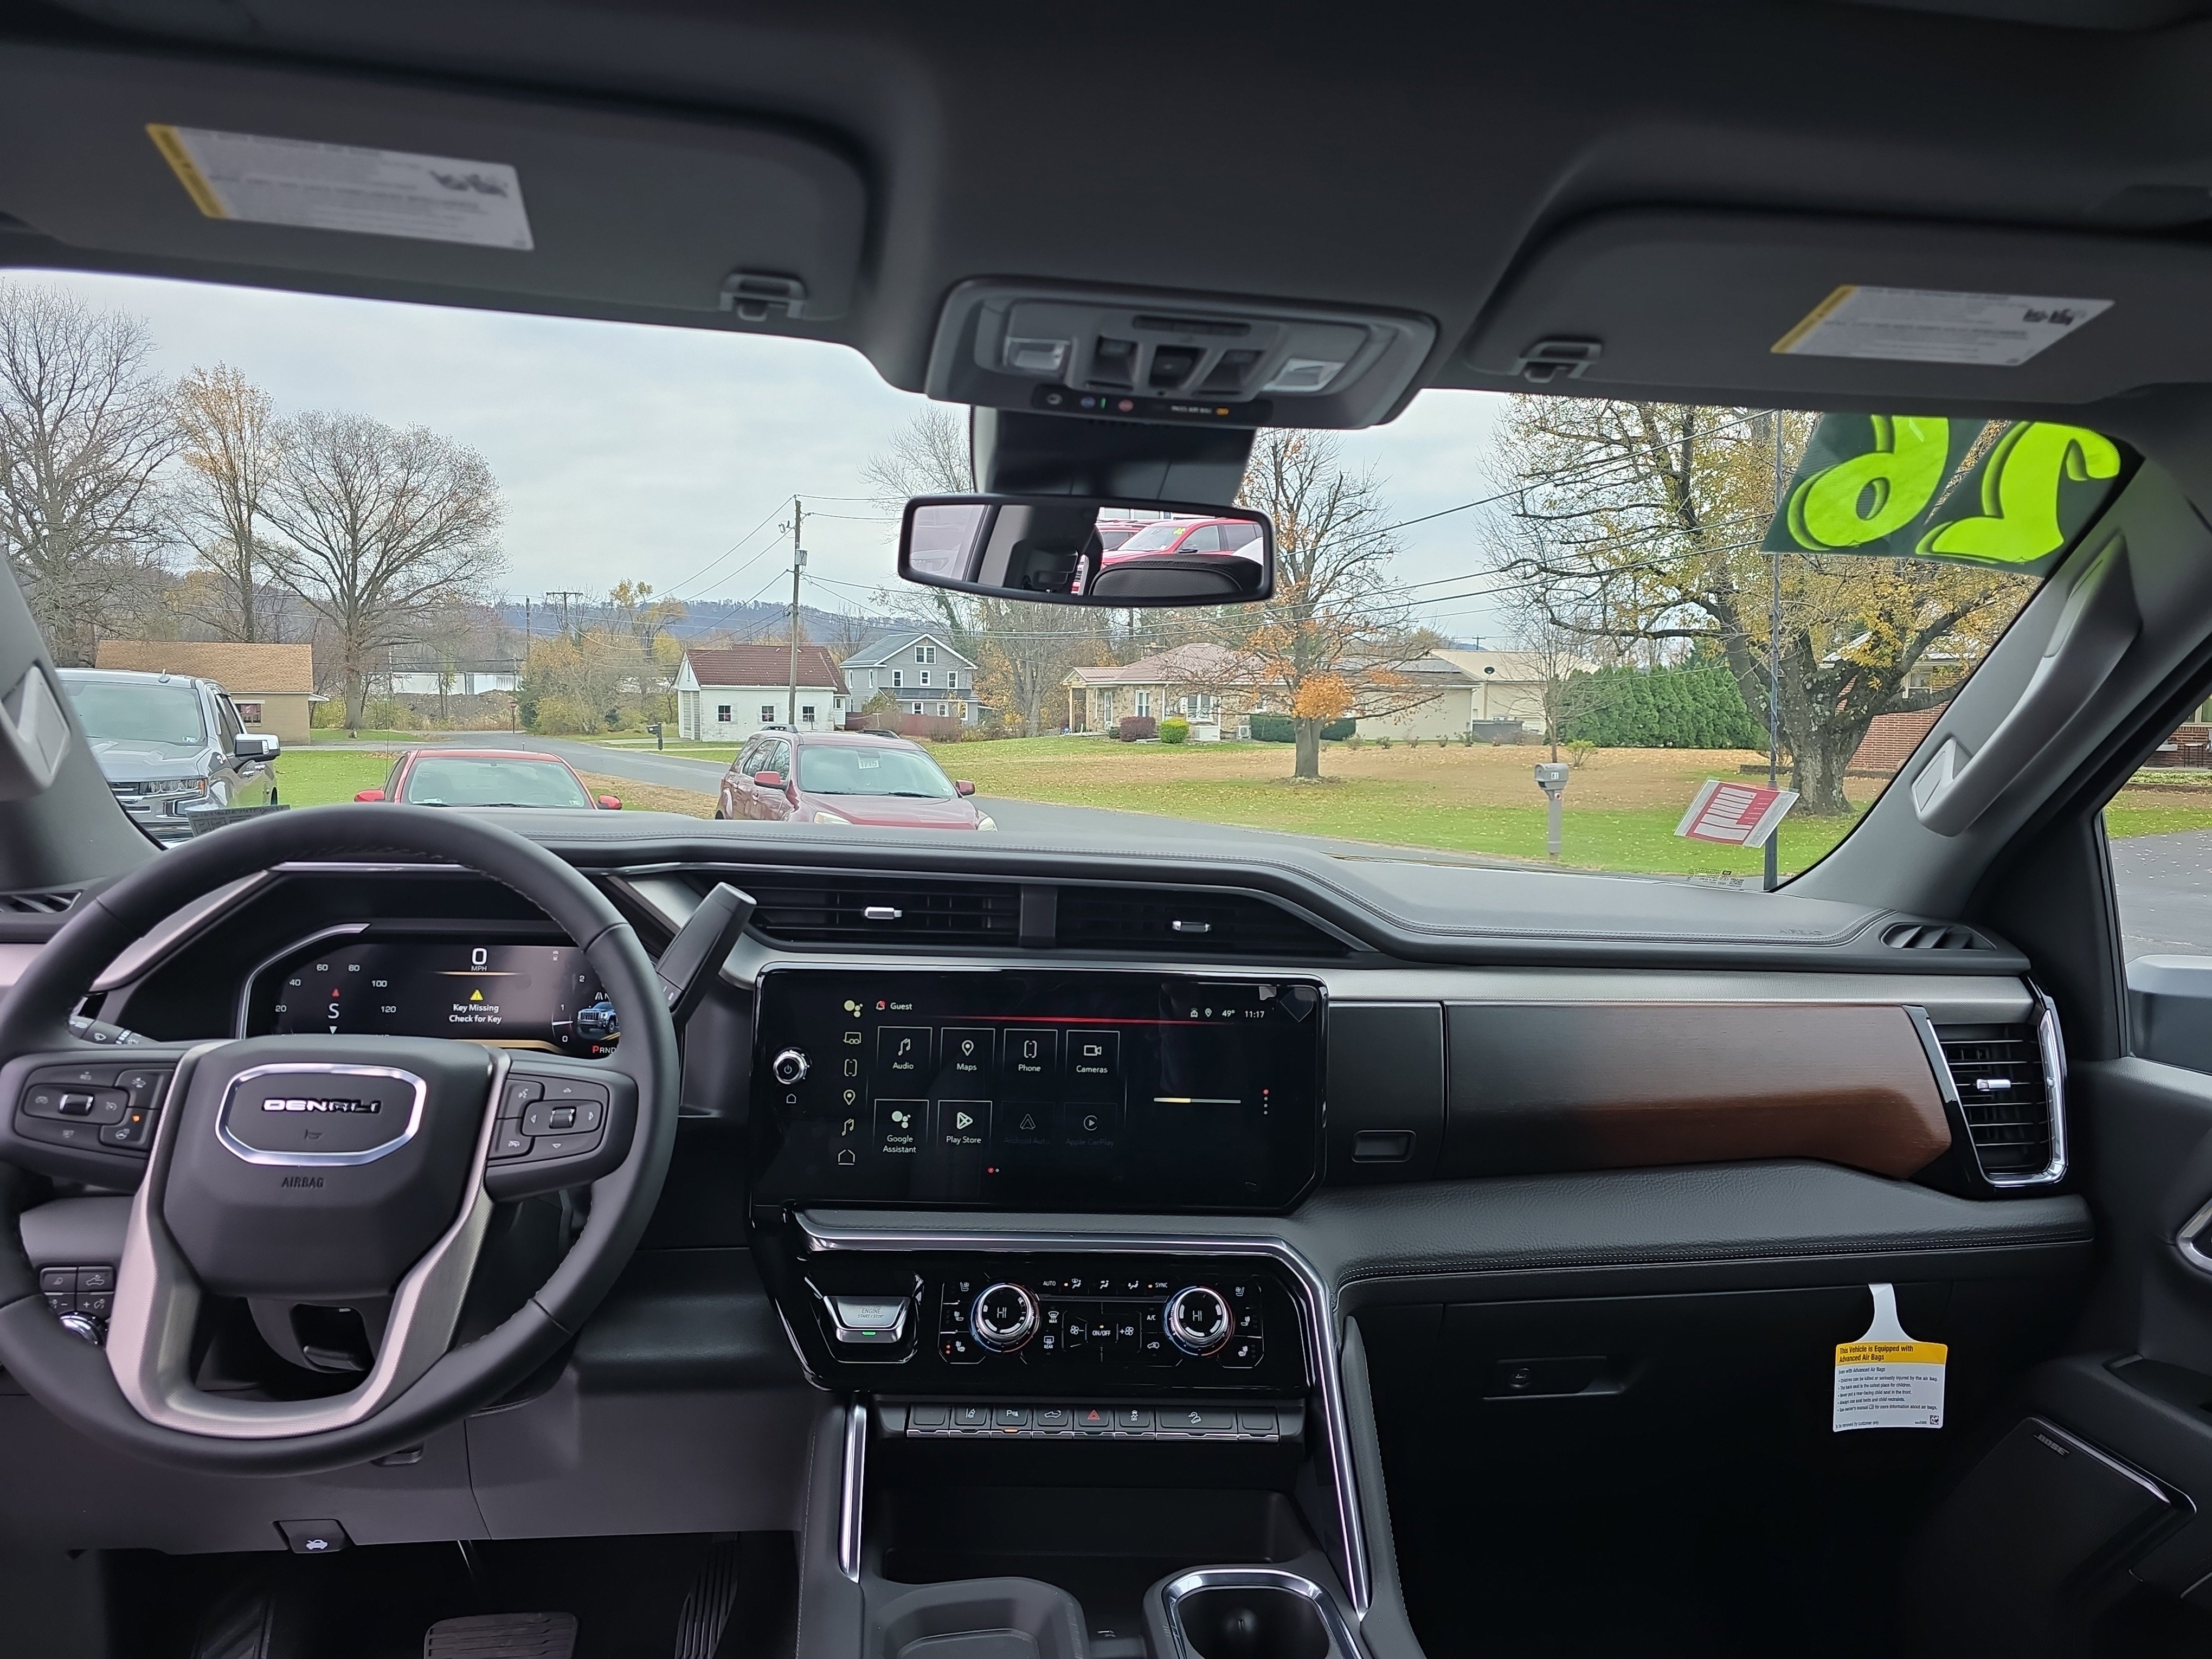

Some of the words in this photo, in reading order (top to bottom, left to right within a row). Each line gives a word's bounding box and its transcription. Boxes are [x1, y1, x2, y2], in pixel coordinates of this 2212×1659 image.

[472, 948, 487, 965] 0
[316, 963, 329, 972] 60
[348, 964, 361, 972] 80
[371, 980, 388, 988] 100
[275, 1005, 287, 1013] 20
[327, 1003, 340, 1019] S
[453, 1004, 468, 1013] Key
[468, 1004, 499, 1013] Missing
[890, 1002, 912, 1012] Guest
[1245, 1010, 1265, 1019] 11:17
[448, 1014, 474, 1023] Check
[487, 1015, 503, 1025] Key
[892, 1062, 914, 1070] Audio
[956, 1063, 977, 1072] Maps
[1018, 1064, 1041, 1072] Phone
[1076, 1065, 1108, 1074] Cameras
[262, 1098, 382, 1113] DENALI
[886, 1135, 914, 1144] Google
[946, 1136, 961, 1145] Play
[962, 1136, 981, 1144] Store
[883, 1145, 917, 1154] Assistant
[281, 1176, 324, 1188] AIRBAG
[996, 1307, 1007, 1319] HI
[1192, 1310, 1203, 1322] HI
[1840, 1354, 1861, 1363] Advanced
[2033, 1433, 2070, 1456] BOSE
